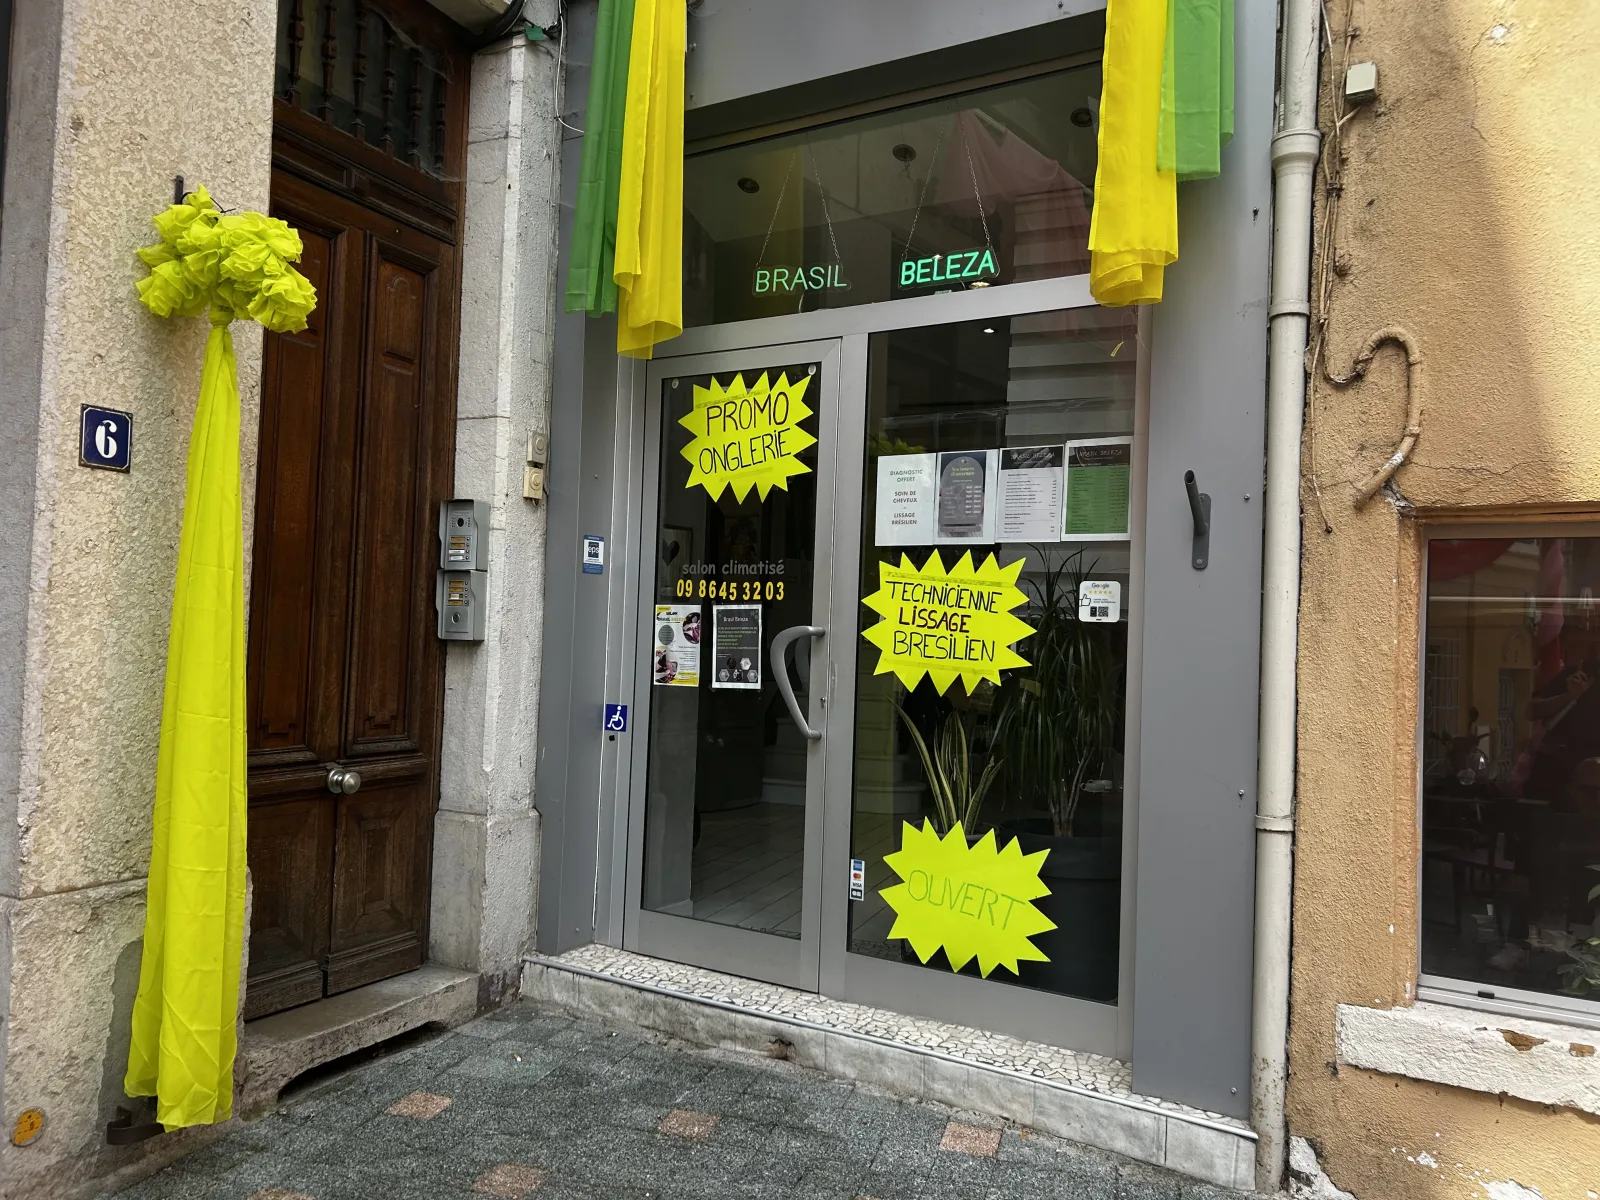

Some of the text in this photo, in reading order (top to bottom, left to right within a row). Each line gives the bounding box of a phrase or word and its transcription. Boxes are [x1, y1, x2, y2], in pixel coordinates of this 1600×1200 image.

[755, 250, 995, 293] BRASIL BELEZA
[705, 391, 789, 436] PROMO
[95, 420, 117, 459] 6
[699, 428, 792, 475] ONGLERIE
[889, 468, 923, 476] DIAGNOSTIC
[682, 559, 785, 575] salon climatisé
[676, 579, 693, 597] 09
[885, 580, 1003, 614] TECHNICIENNE
[898, 607, 972, 634] LISSAGE
[893, 631, 996, 662] BRESILIEN
[908, 869, 1026, 931] OUVERT
